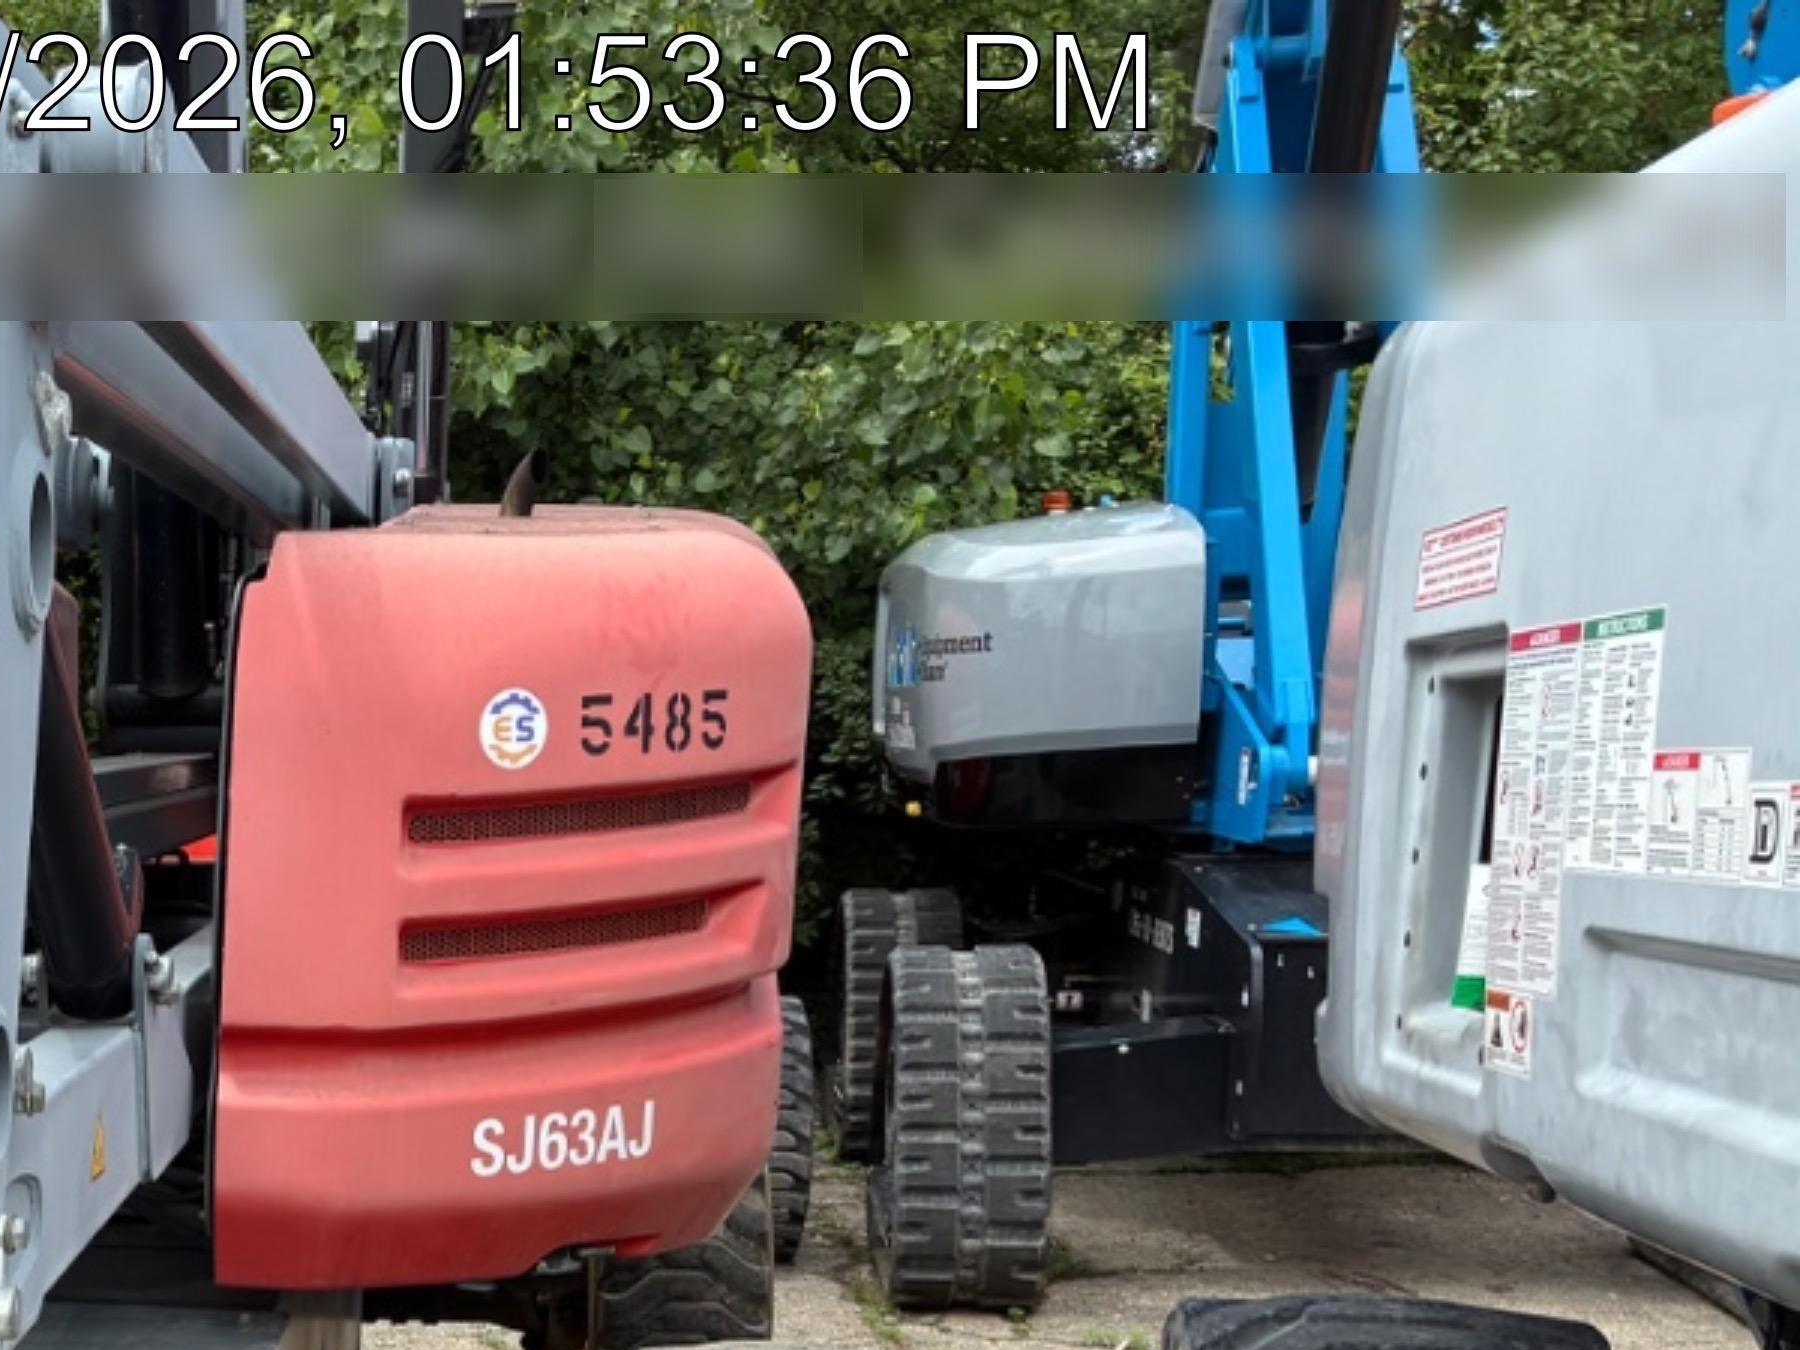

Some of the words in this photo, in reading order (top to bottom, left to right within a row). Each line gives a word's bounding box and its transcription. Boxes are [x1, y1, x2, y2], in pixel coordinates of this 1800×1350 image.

[491, 715, 536, 743] ES
[580, 689, 728, 757] 5485
[470, 1099, 656, 1178] SJ63AJ
